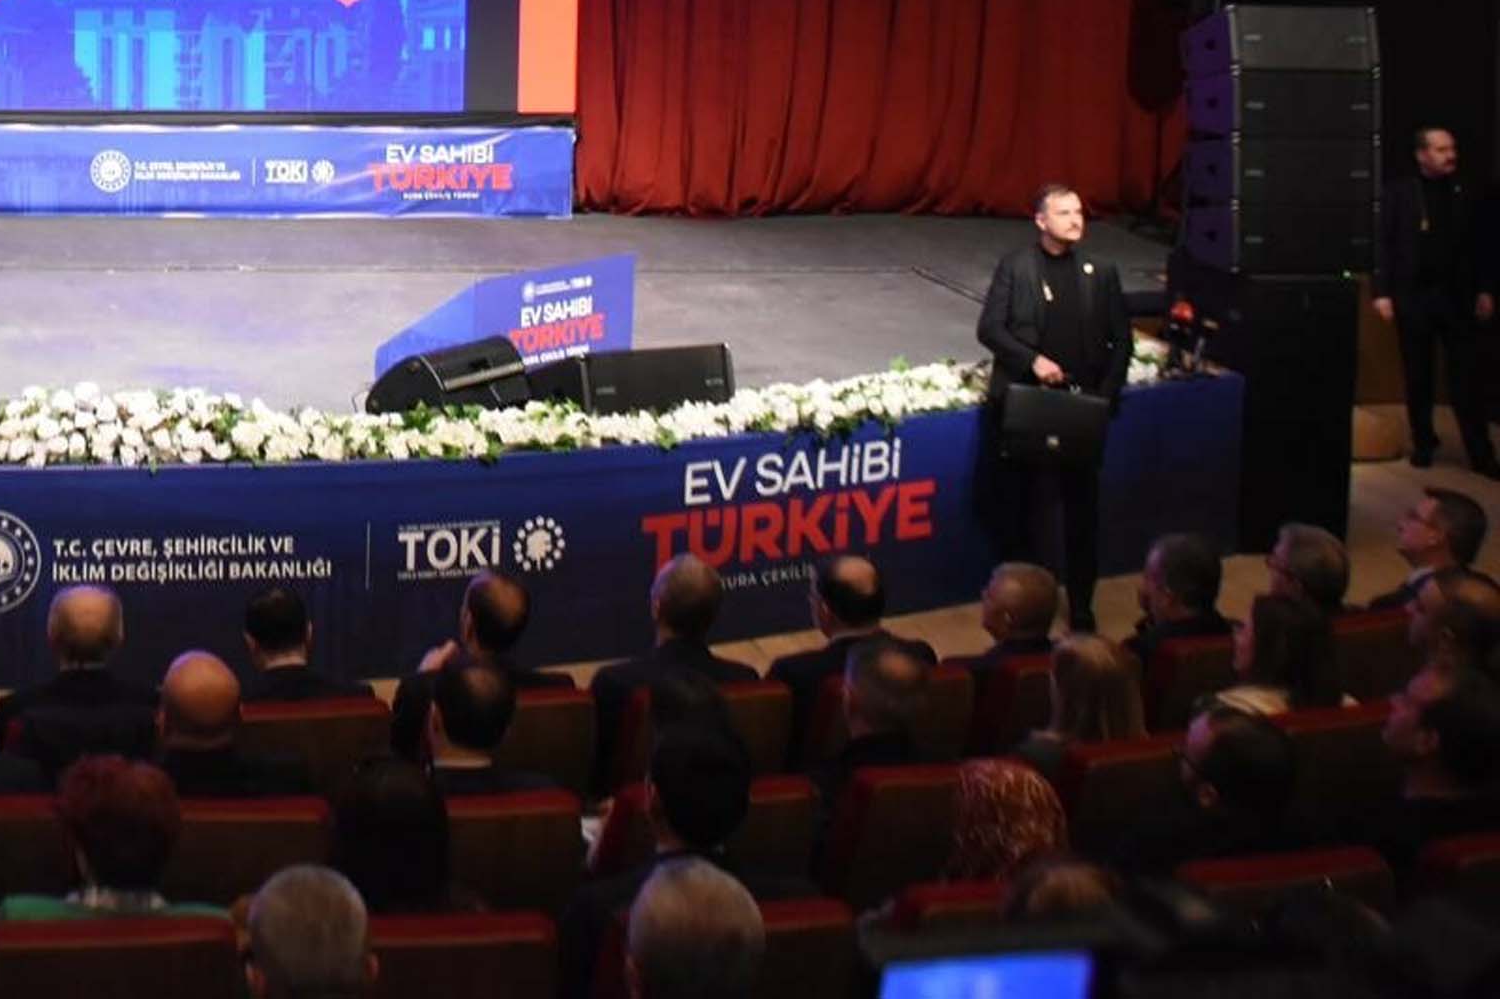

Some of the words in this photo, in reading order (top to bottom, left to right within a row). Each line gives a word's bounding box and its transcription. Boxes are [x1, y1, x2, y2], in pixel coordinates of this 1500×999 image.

[386, 143, 416, 163] EV
[521, 305, 542, 328] EV
[683, 456, 747, 505] EV
[755, 437, 901, 496] SAHİBİ
[640, 478, 936, 575] TÜRKİYE
[53, 538, 86, 557] T.C.
[92, 538, 157, 560] ÇEVRE,
[163, 534, 266, 560] ŞEHİRCİLİK
[270, 536, 294, 554] VE
[398, 527, 500, 570] TOKİ
[52, 561, 105, 582] İKLİM
[111, 559, 224, 584] DEĞİŞİKLİĞİ
[229, 557, 332, 579] BAKANLIĞI
